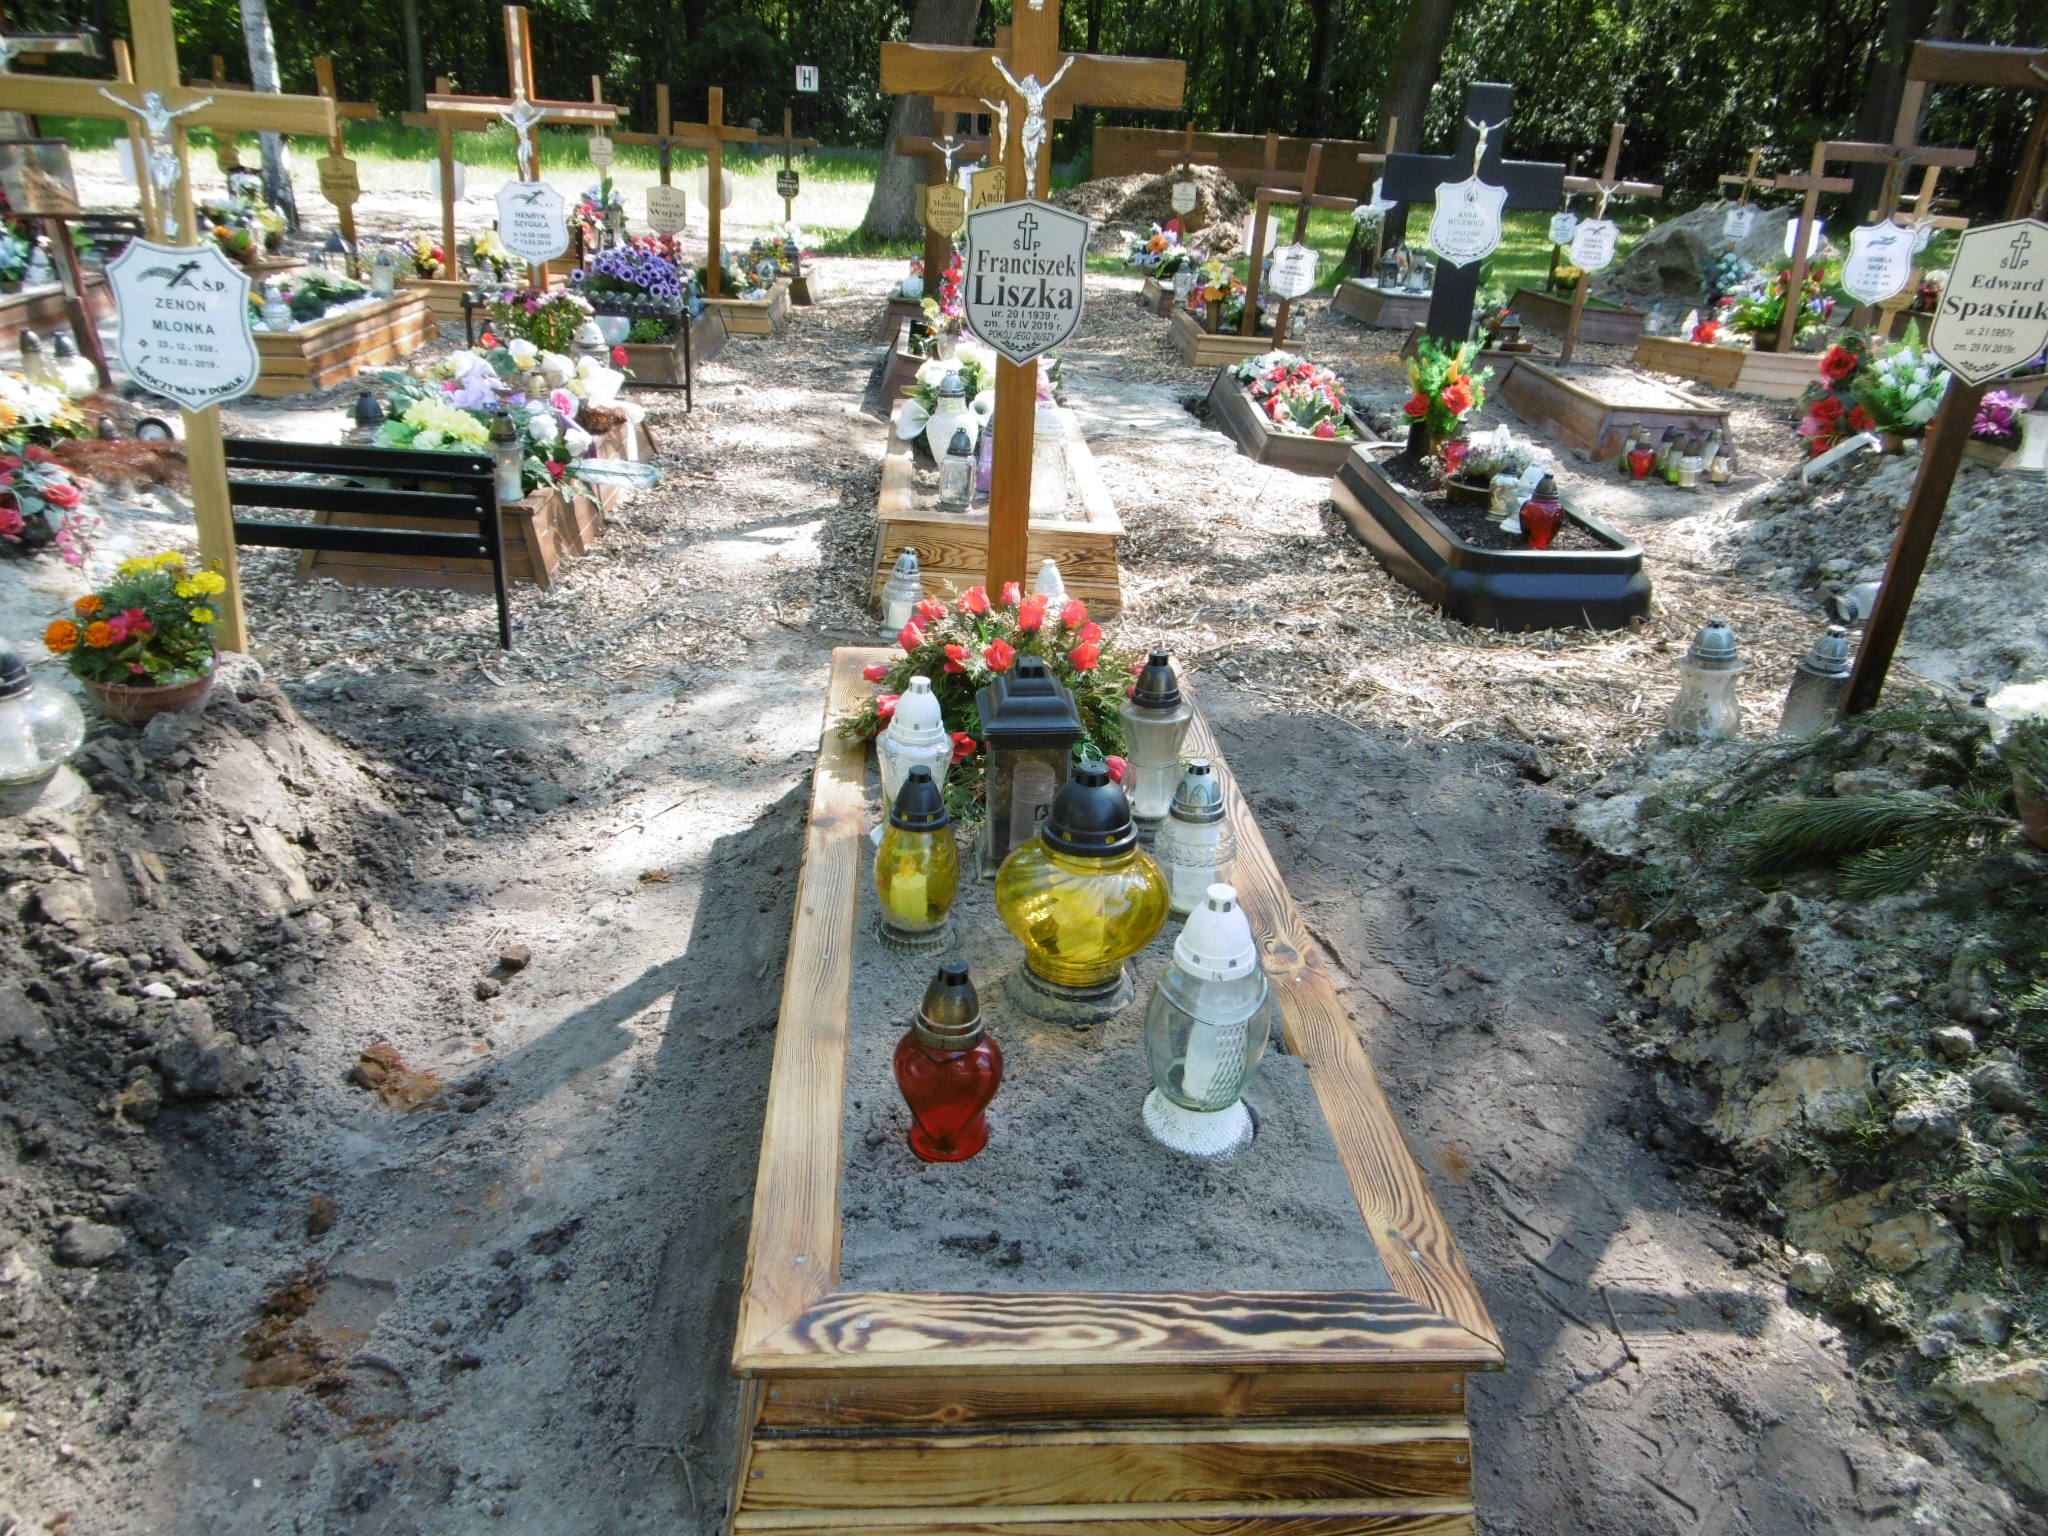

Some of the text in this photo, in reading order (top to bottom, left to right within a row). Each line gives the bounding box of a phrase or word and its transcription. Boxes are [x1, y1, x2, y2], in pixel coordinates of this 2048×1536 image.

[802, 69, 812, 88] H
[514, 211, 547, 220] HENRYK
[1033, 241, 1041, 250] P
[977, 249, 1076, 277] Franciszek
[2019, 259, 2029, 270] P
[1970, 274, 2044, 292] Edward
[973, 275, 1074, 310] Liszka
[155, 297, 206, 312] ZENON
[1943, 295, 2048, 322] Spasiuk
[991, 310, 1004, 318] ur.
[1007, 309, 1019, 319] 20
[1028, 310, 1051, 320] 1939
[152, 319, 216, 335] MLONKA
[984, 320, 1000, 328] zm.
[1006, 320, 1017, 329] 16
[1019, 320, 1028, 329] IV
[1031, 320, 1054, 330] 2019
[1012, 331, 1032, 340] JEGO
[1032, 331, 1056, 341] DUSZY
